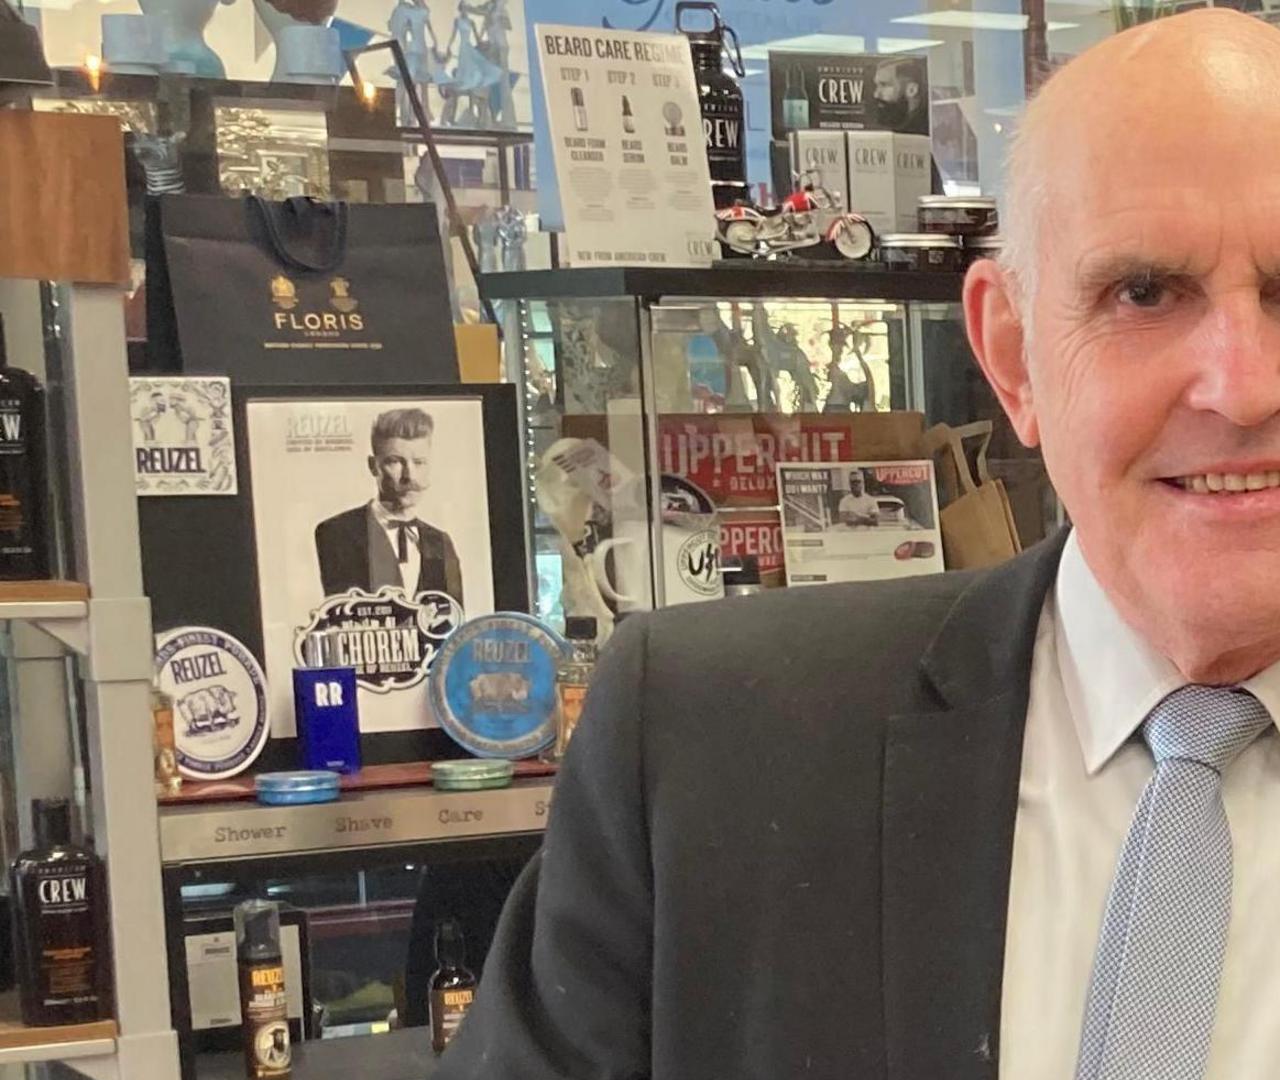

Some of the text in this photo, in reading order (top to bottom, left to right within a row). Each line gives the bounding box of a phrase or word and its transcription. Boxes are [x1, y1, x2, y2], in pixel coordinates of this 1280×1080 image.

[545, 35, 685, 64] BEARD CARE REGIME
[560, 67, 581, 81] STEP
[608, 70, 627, 84] STEP
[652, 74, 672, 87] STEP
[819, 79, 863, 104] CREW
[704, 118, 739, 148] REW
[806, 148, 837, 165] CREW
[855, 148, 887, 165] CREW
[897, 152, 924, 168] CREW
[274, 312, 364, 330] FLORIS
[136, 447, 207, 474] REUZEL
[662, 431, 846, 477] UPPERCUT
[730, 476, 776, 491] DELUX
[875, 466, 928, 482] UPPERCUT
[720, 526, 782, 555] PPERC
[337, 628, 421, 667] CHOREM
[170, 651, 228, 685] REUZEL
[315, 682, 344, 707] RR
[214, 825, 287, 843] Shower
[335, 817, 393, 833] Shave
[438, 809, 484, 824] Care
[39, 878, 87, 904] CREW
